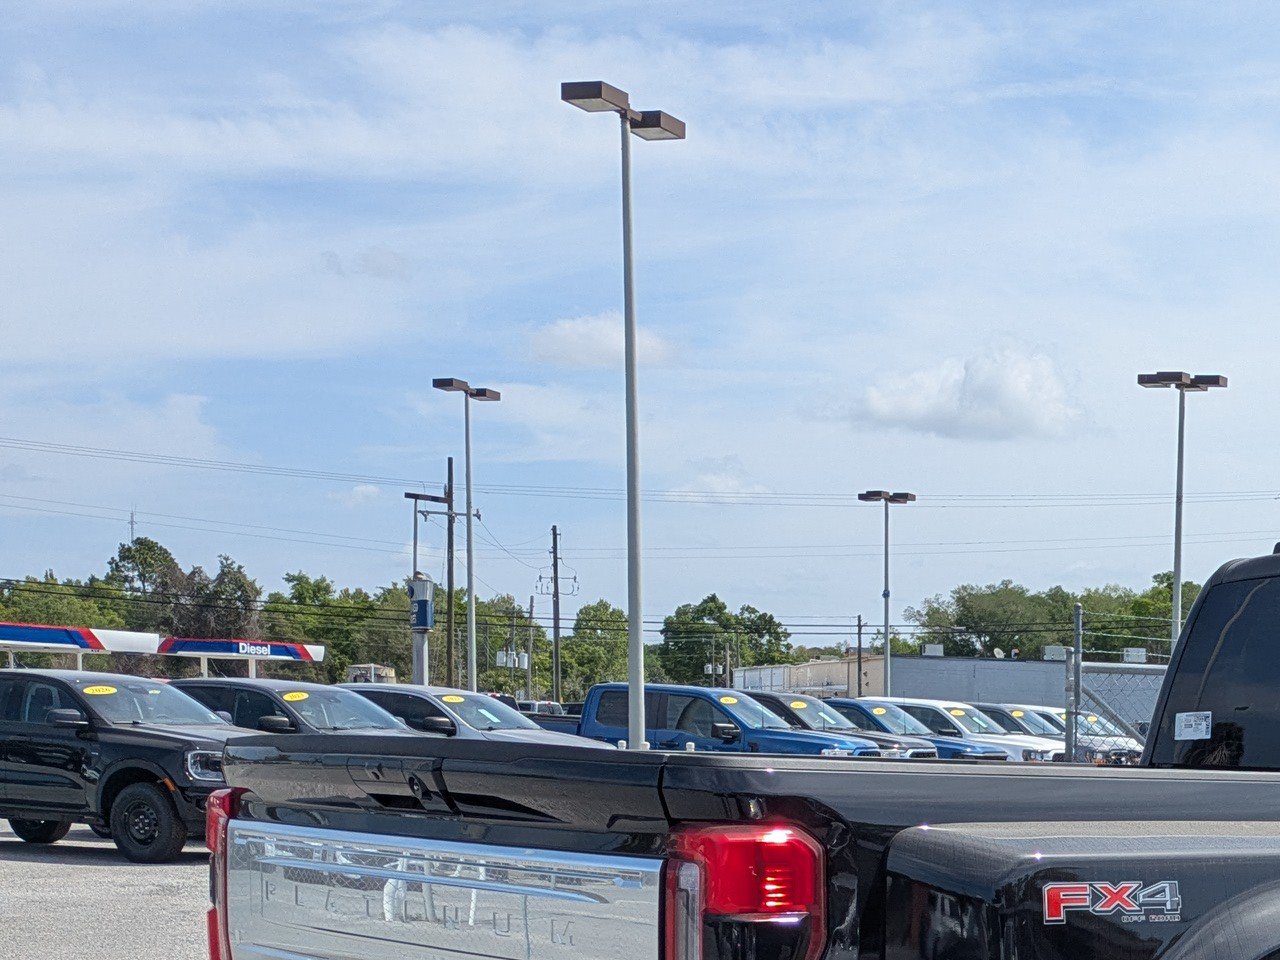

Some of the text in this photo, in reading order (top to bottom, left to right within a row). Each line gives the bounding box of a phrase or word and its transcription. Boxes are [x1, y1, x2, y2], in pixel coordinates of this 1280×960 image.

[239, 642, 271, 656] Diesel
[264, 880, 576, 948] PLATINUM
[1043, 881, 1182, 925] FX4
[1122, 914, 1181, 923] OFF ROAD
